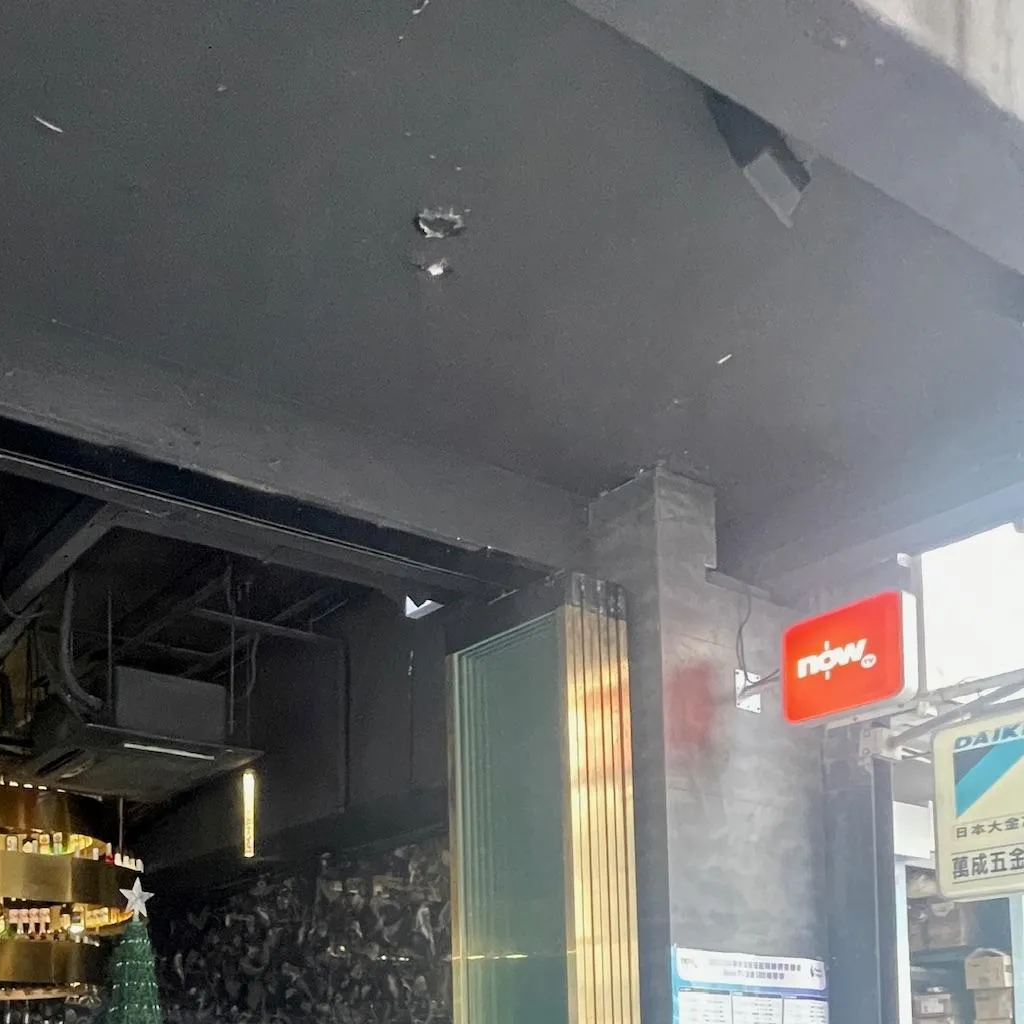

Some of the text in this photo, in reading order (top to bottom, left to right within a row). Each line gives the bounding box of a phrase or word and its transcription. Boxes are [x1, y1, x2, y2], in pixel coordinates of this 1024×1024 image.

[797, 637, 867, 680] now
[954, 722, 1024, 749] DAIK
[956, 816, 1024, 839] 日本大金
